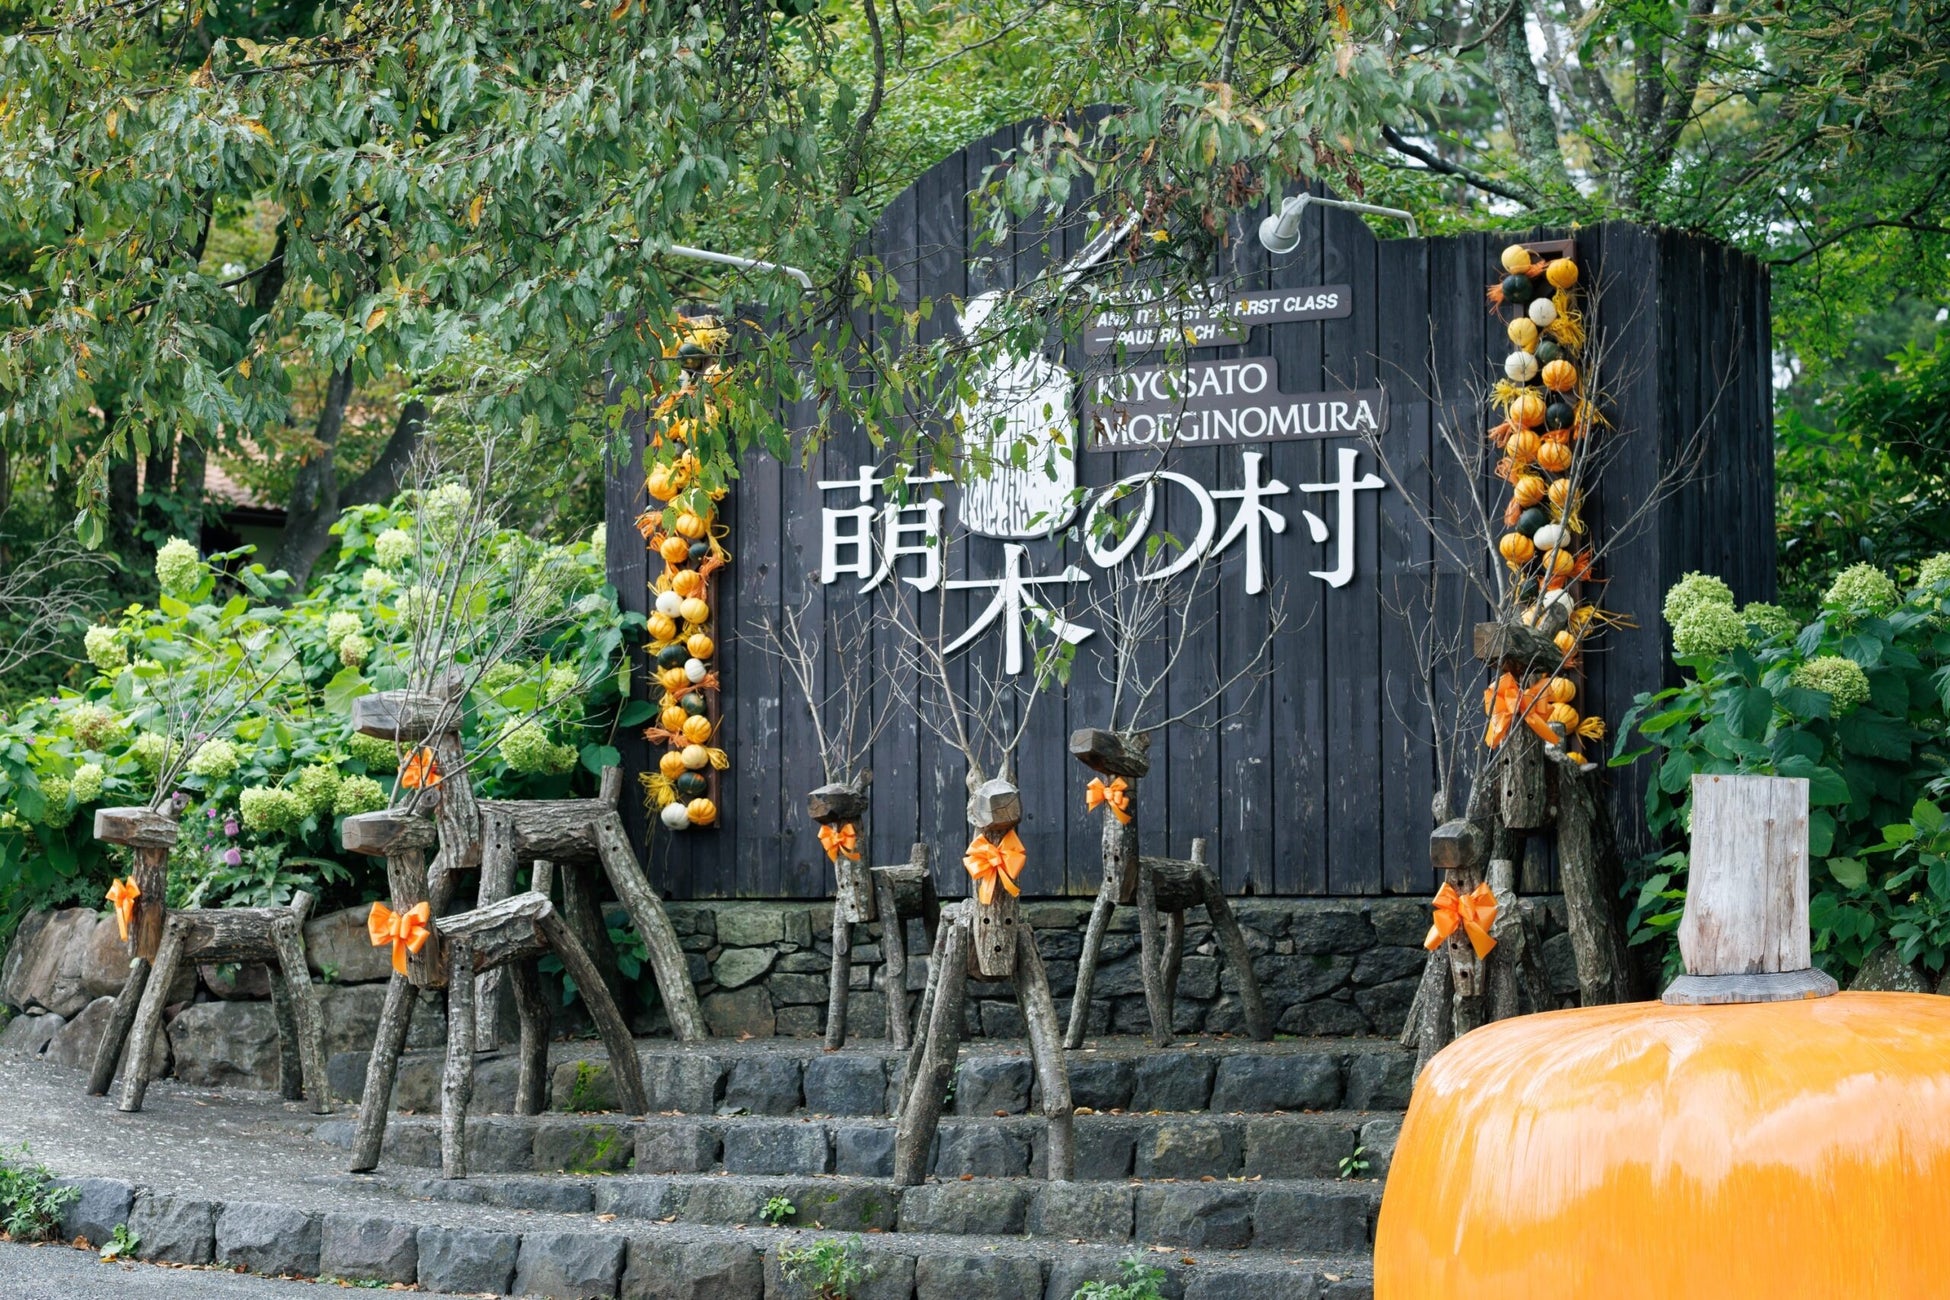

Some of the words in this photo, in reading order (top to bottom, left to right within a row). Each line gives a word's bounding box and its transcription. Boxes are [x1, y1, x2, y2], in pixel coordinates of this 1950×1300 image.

[1283, 293, 1339, 312] CLASS
[1160, 324, 1215, 343] RUCH
[1096, 363, 1268, 404] KIYOSATO
[1097, 400, 1379, 446] MOEGINOMURA
[817, 448, 1386, 676] 萌木の村
